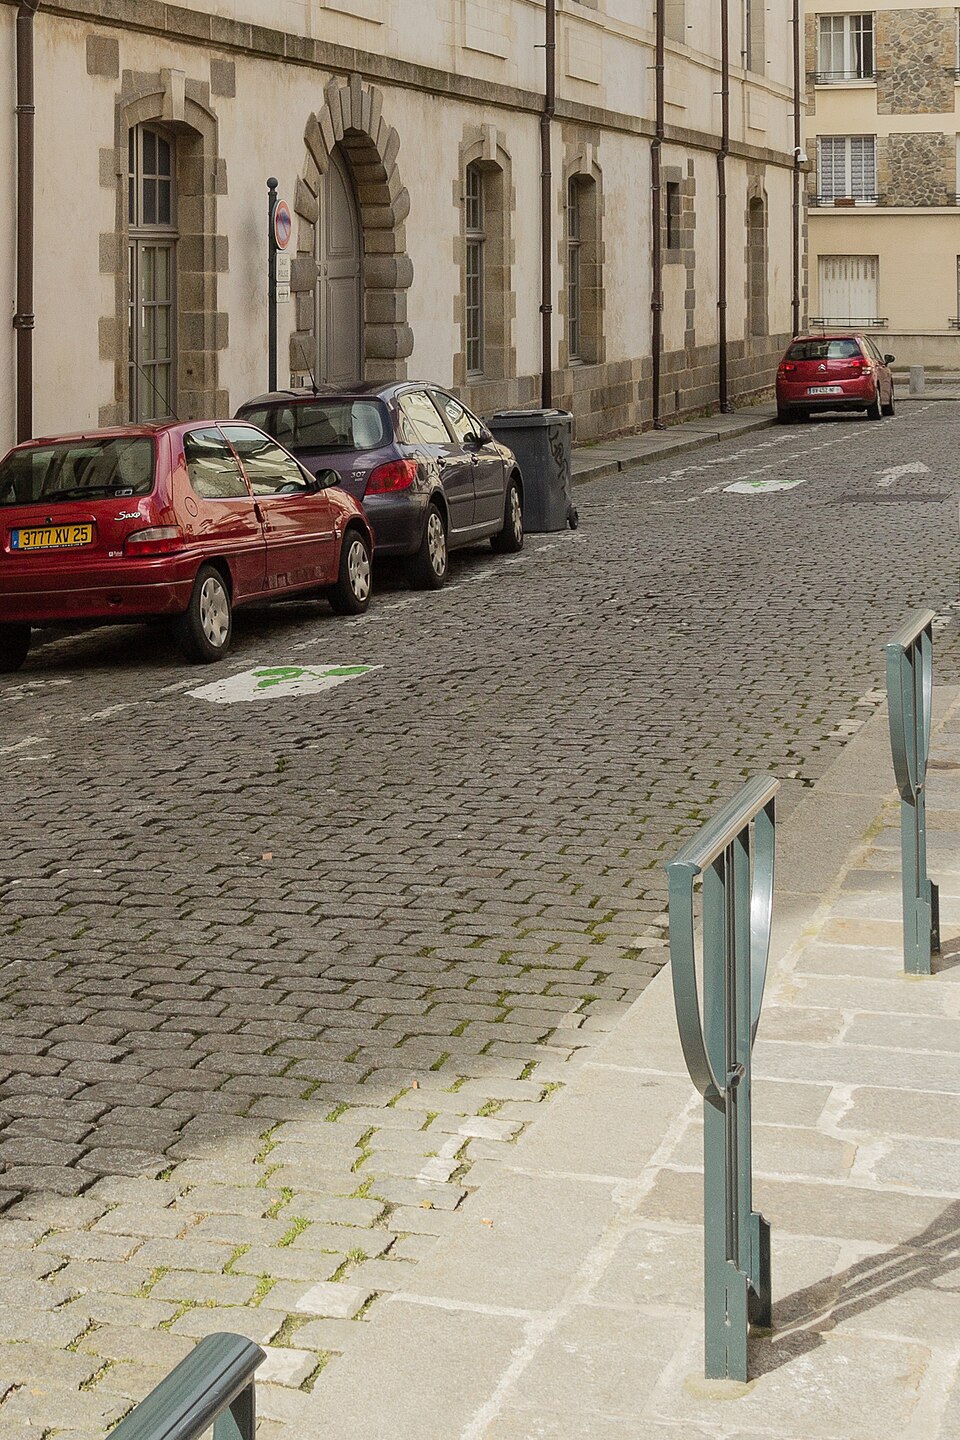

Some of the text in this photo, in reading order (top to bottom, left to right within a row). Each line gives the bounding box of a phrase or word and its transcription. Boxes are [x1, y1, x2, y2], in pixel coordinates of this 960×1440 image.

[114, 511, 141, 521] Saxo
[23, 530, 52, 546] 3777
[55, 528, 70, 544] XV
[73, 527, 88, 542] 25
